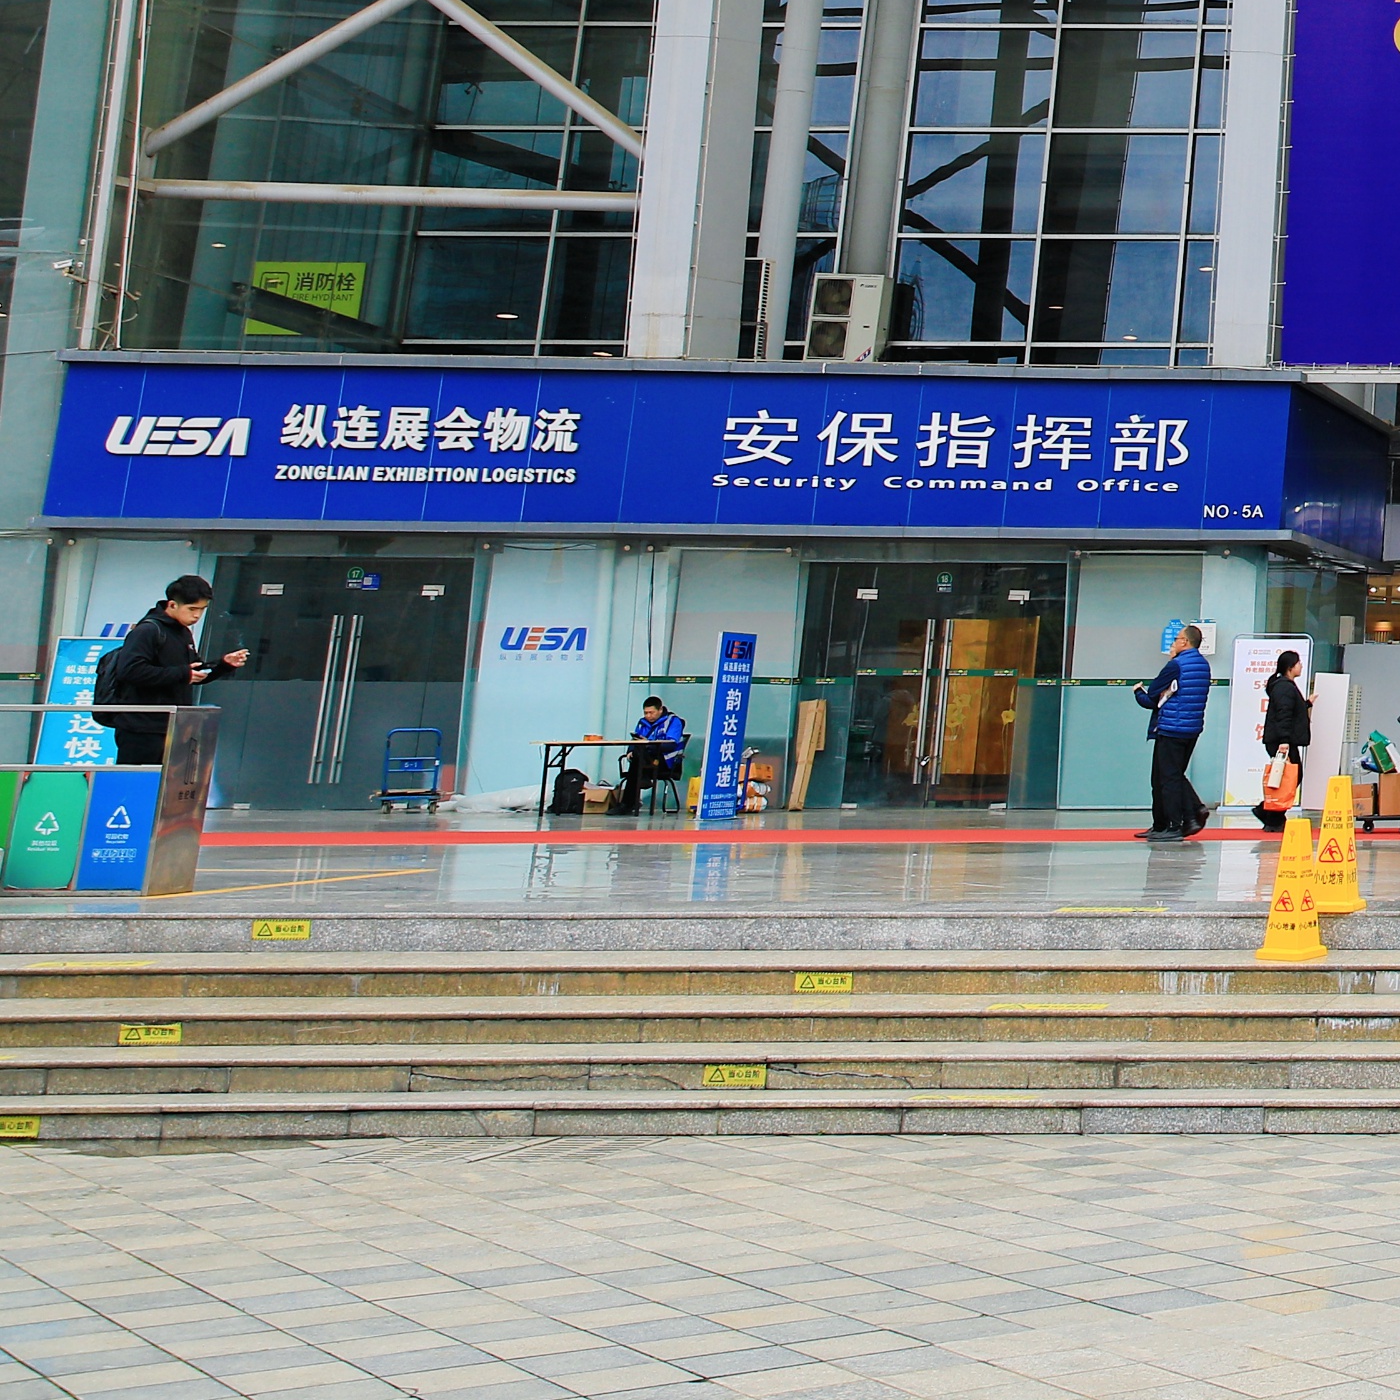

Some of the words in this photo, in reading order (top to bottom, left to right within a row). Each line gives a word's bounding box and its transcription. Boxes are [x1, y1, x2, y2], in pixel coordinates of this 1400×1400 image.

[294, 272, 356, 291] 消防栓
[105, 415, 252, 458] UESA
[279, 403, 583, 454] 纵连展会物流
[722, 409, 1191, 474] 安保指挥部
[274, 465, 369, 482] ZONGLIAN
[372, 466, 479, 484] EXHIBITION
[481, 467, 577, 485] LOGISTICS
[712, 474, 857, 492] Security
[883, 475, 1054, 492] Command
[1076, 477, 1180, 493] Office
[500, 627, 588, 651] UESA
[715, 688, 742, 788] 韵达快递
[817, 977, 846, 985] 当心台阶
[728, 1070, 760, 1078] 当心台阶
